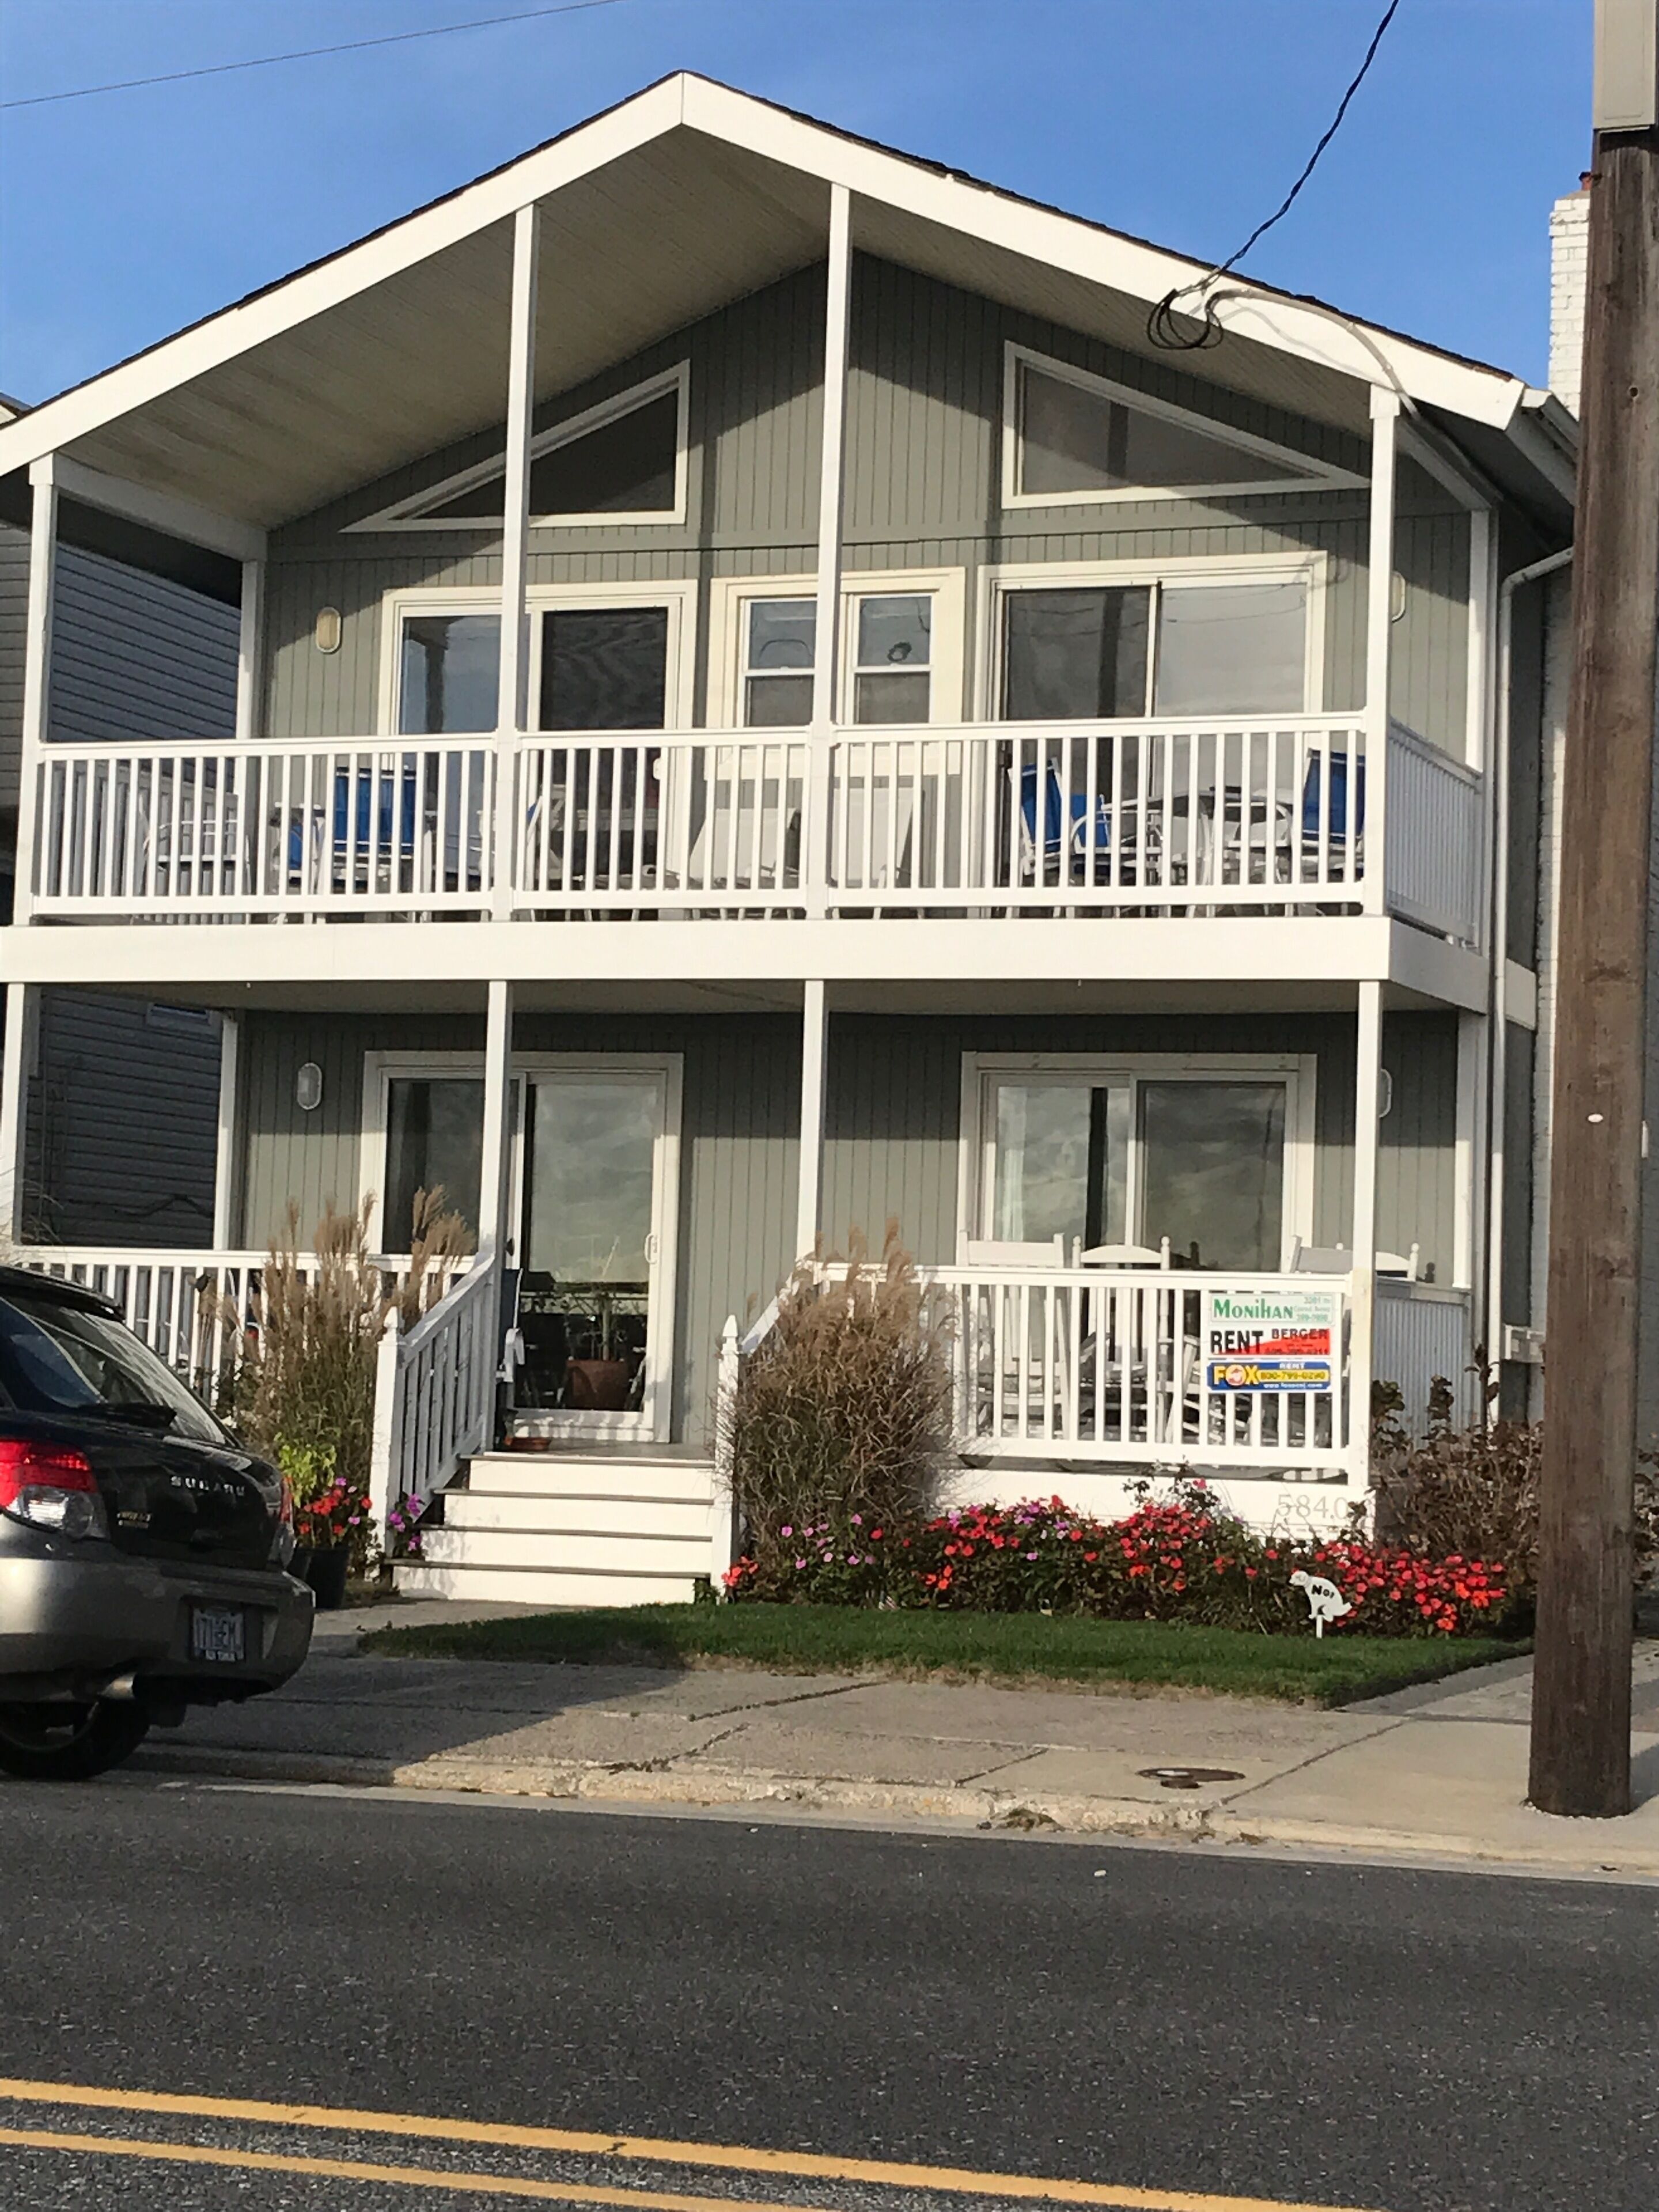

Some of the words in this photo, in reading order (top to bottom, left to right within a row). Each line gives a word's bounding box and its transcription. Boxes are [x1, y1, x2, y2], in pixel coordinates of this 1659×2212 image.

[1210, 1331, 1264, 1354] RENT
[1271, 1328, 1328, 1339] BERGER
[1277, 1494, 1349, 1520] 5840
